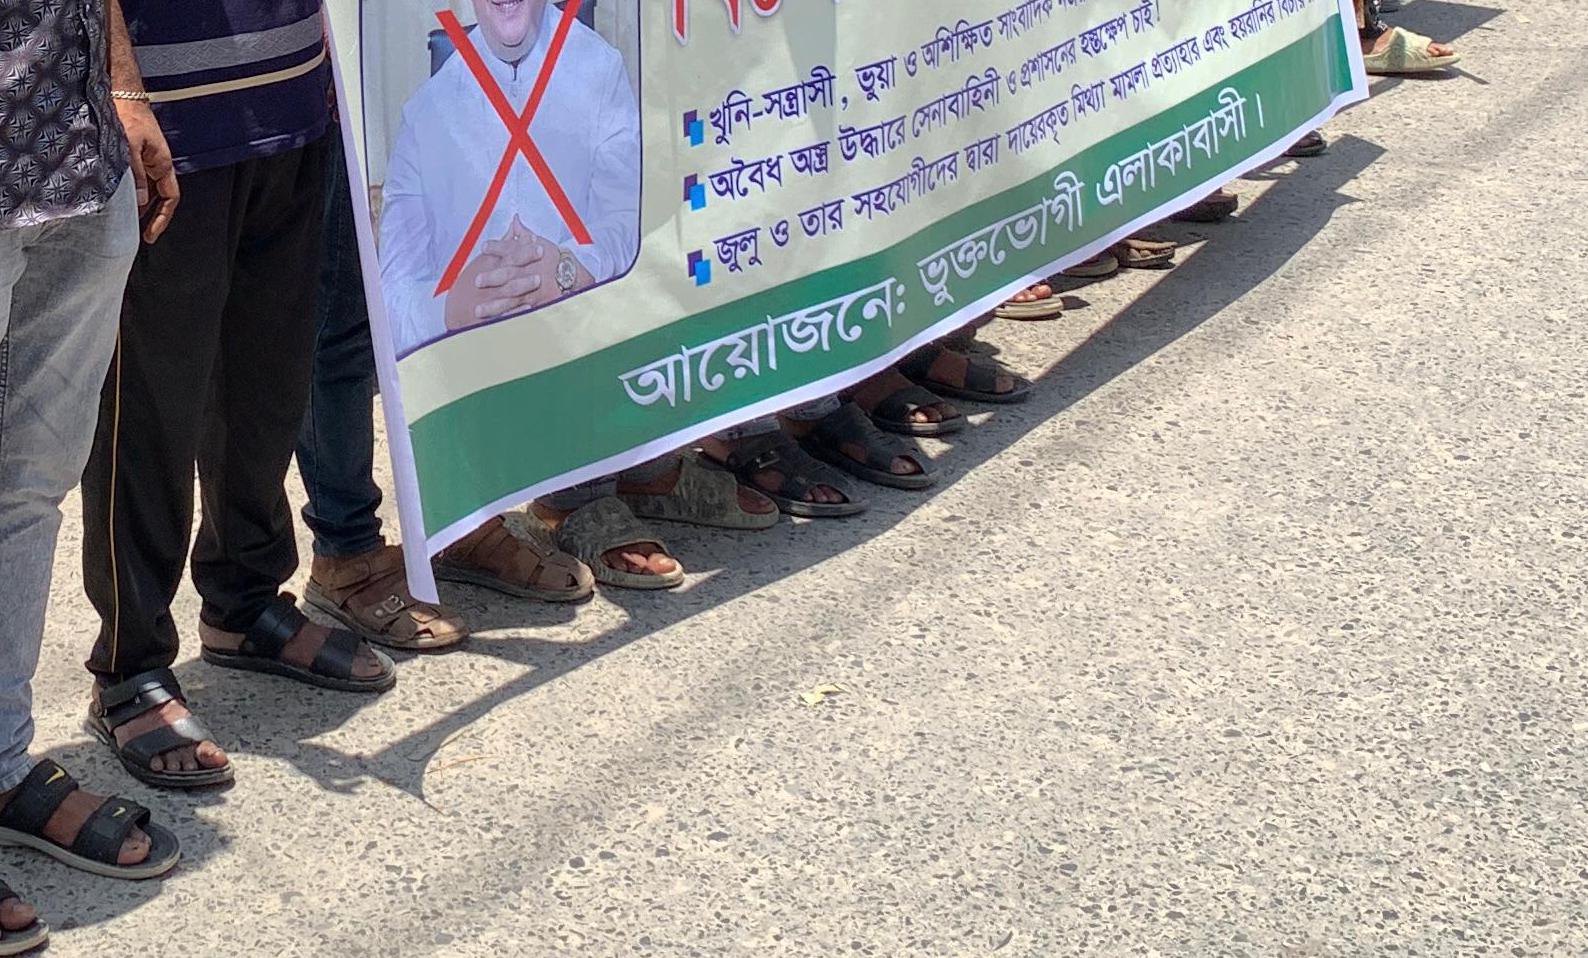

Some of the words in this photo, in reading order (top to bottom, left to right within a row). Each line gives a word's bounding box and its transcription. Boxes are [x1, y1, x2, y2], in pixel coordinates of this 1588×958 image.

[708, 155, 784, 201] অবৈধ
[788, 141, 831, 177] অস্ত্র
[838, 115, 907, 162] উদ্ধারে
[912, 66, 1001, 138] সেনাবাহিনী
[1006, 70, 1017, 96] ও
[1020, 37, 1077, 90] প্রশাসনের
[1080, 11, 1130, 58] হস্তক্ষেপ
[855, 57, 897, 102] ভুয়া
[904, 51, 917, 78] ও
[921, 19, 993, 67] অশিক্ষিত
[714, 226, 763, 274] জুলু
[770, 219, 790, 248] ও
[797, 198, 844, 238] তার
[851, 156, 960, 223] সহযোগীদের
[965, 133, 1000, 174] দ্বারা
[1006, 99, 1069, 155] দায়েরকৃত
[1072, 80, 1106, 125] মিথ্যা
[1110, 59, 1150, 103] মামলা
[1152, 35, 1202, 82] প্রত্যাহার
[1203, 24, 1230, 55] এবং
[918, 172, 1085, 306] ভুক্তভোগী
